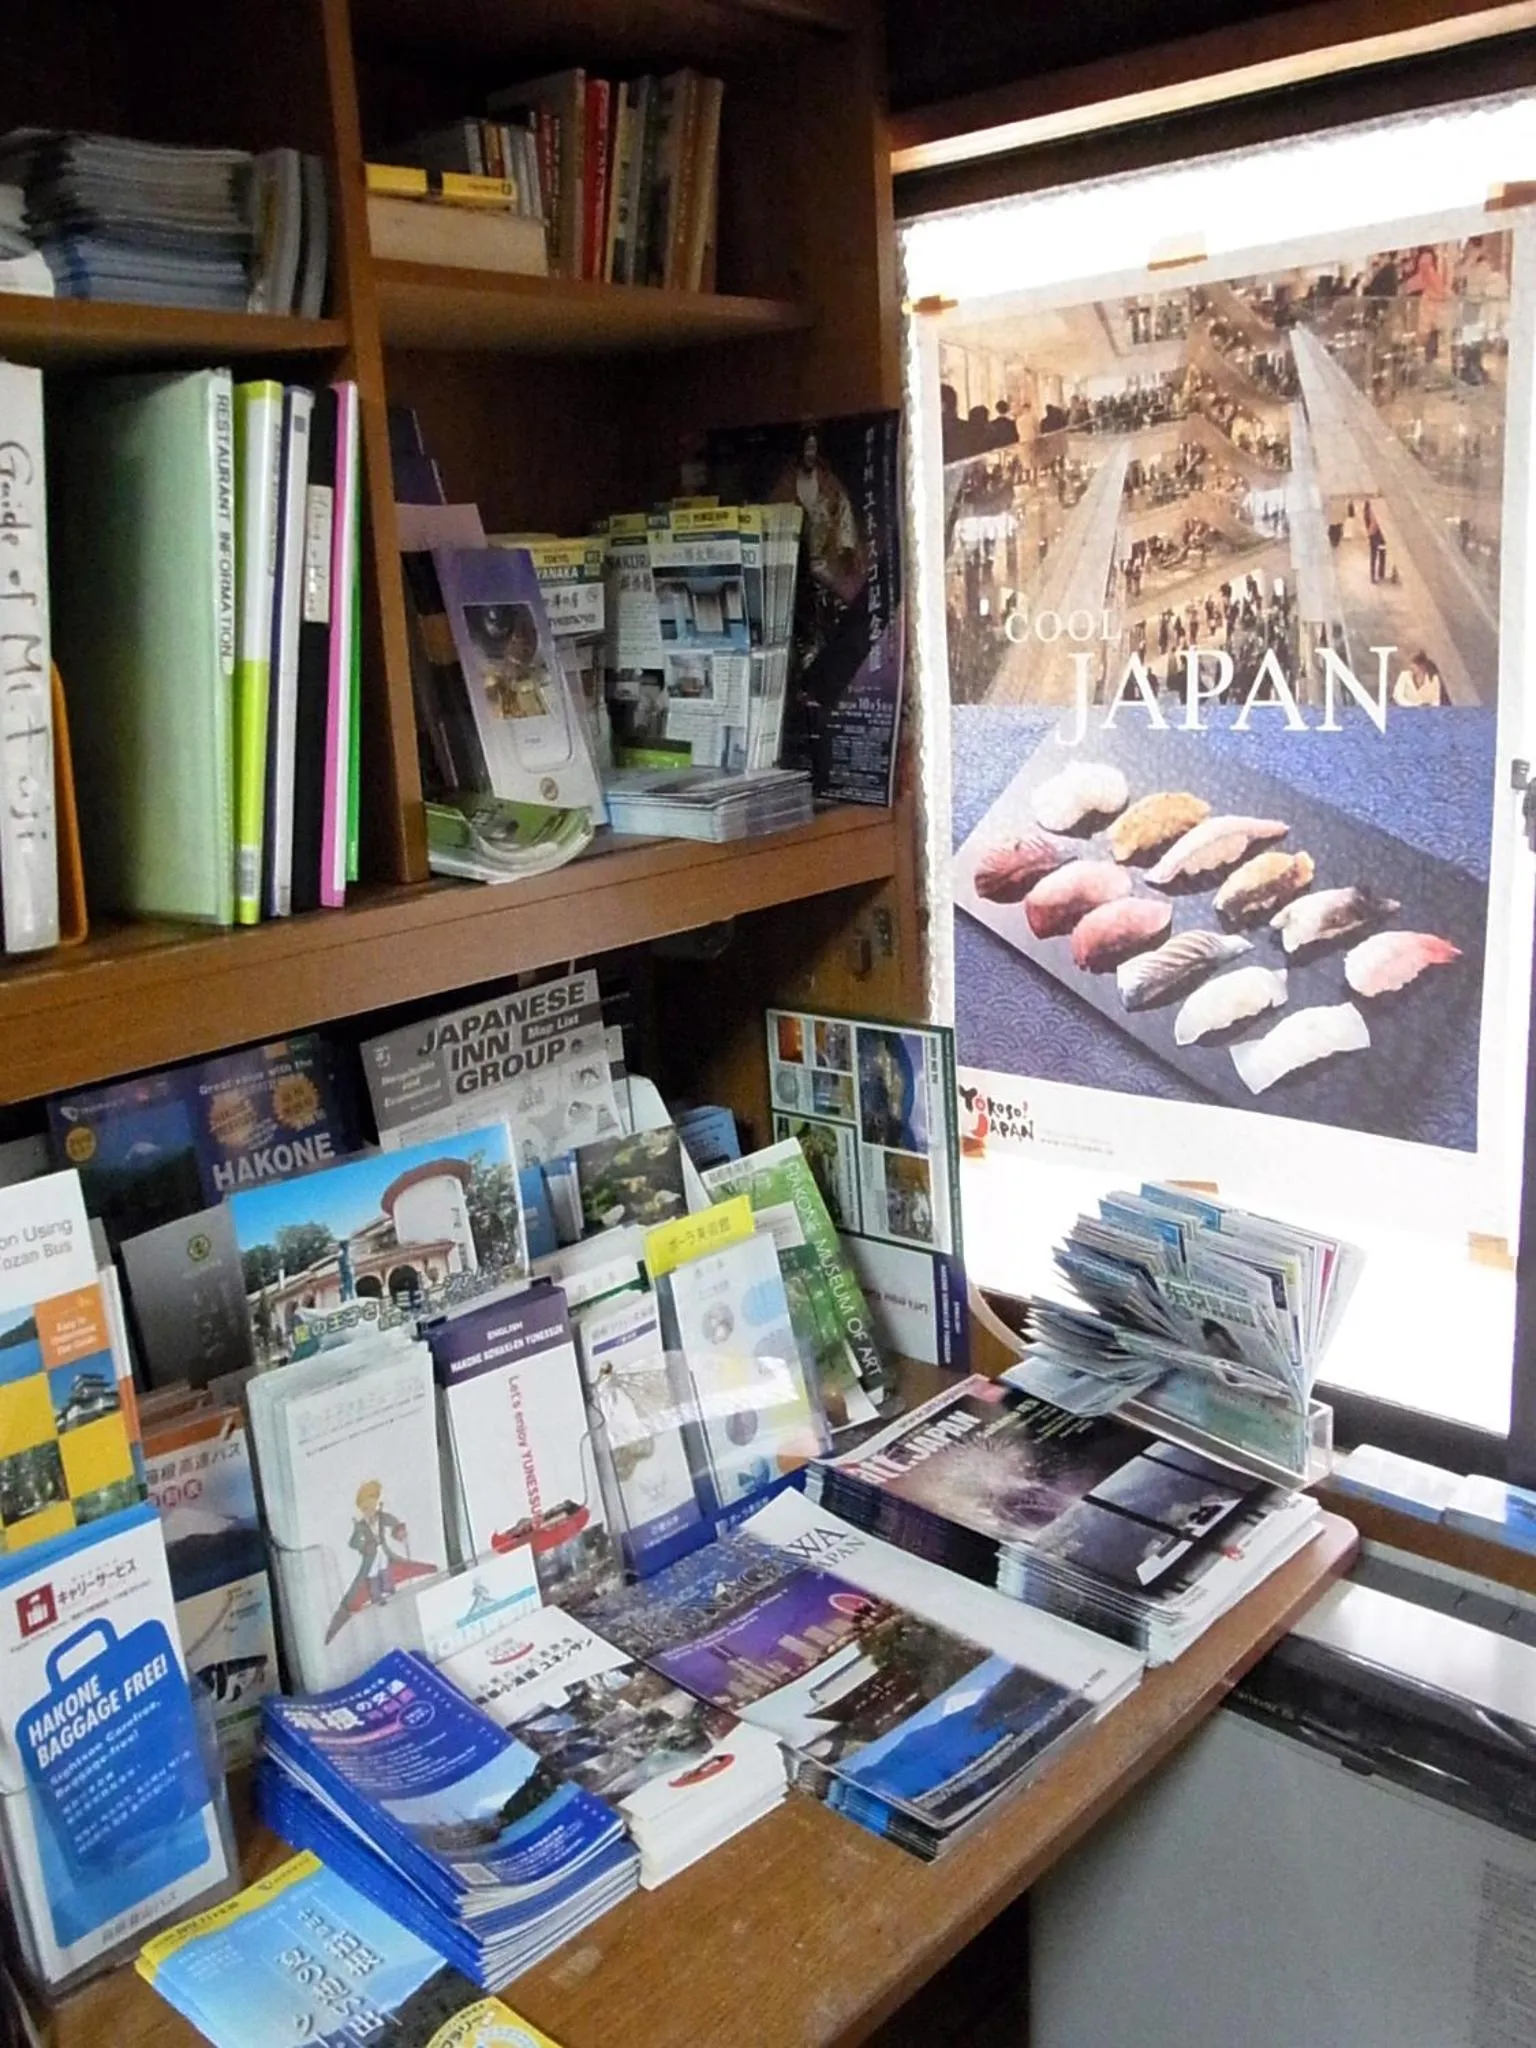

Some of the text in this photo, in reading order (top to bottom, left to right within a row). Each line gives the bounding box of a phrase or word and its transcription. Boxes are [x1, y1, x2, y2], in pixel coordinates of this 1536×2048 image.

[216, 394, 232, 658] RESTAURANT INFORMATION
[1004, 608, 1123, 644] COOL
[1055, 645, 1399, 745] JAPAN
[417, 980, 586, 1056] JAPANESE
[452, 1032, 511, 1072] INN
[556, 1012, 580, 1031] List
[456, 1037, 566, 1095] GROUP
[212, 1132, 336, 1193] HAKONE
[1, 1241, 73, 1271] ozan Bus
[21, 1218, 74, 1242] Using
[814, 1238, 855, 1316] MUSEUM
[847, 1316, 868, 1343] OF
[857, 1346, 883, 1378] ART
[812, 1536, 867, 1572] APAN
[28, 1673, 102, 1748] HAKONE
[36, 1652, 169, 1770] BAGGAGE FREE!
